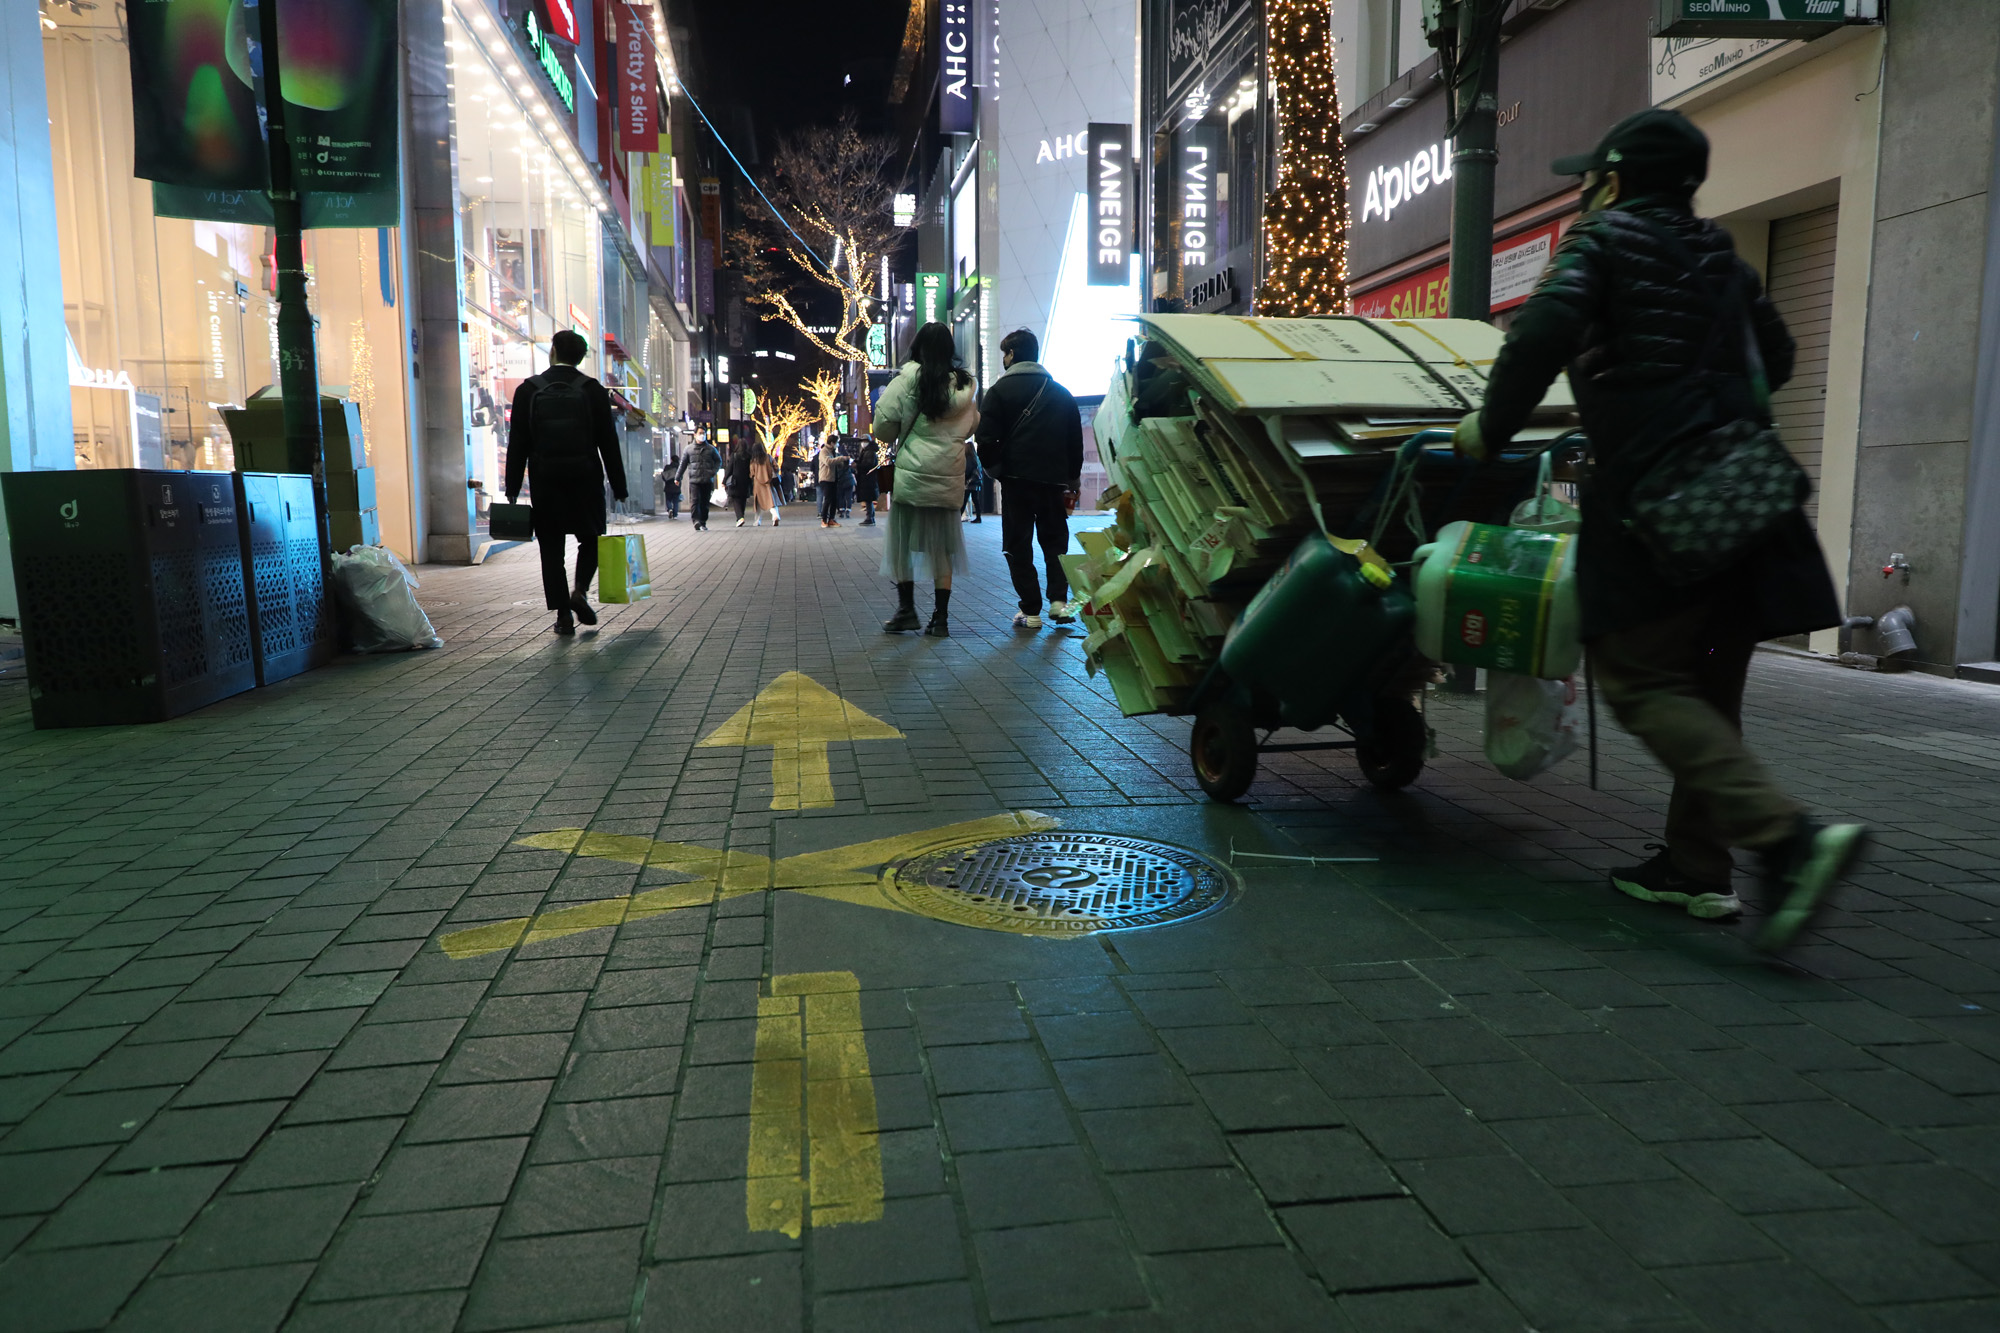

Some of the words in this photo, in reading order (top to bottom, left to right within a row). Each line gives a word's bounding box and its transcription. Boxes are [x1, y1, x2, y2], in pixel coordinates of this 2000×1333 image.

[946, 31, 967, 100] AHC
[630, 95, 648, 135] skin
[1497, 101, 1522, 127] our
[1099, 143, 1122, 265] LANEIGE
[209, 315, 225, 379] Collection
